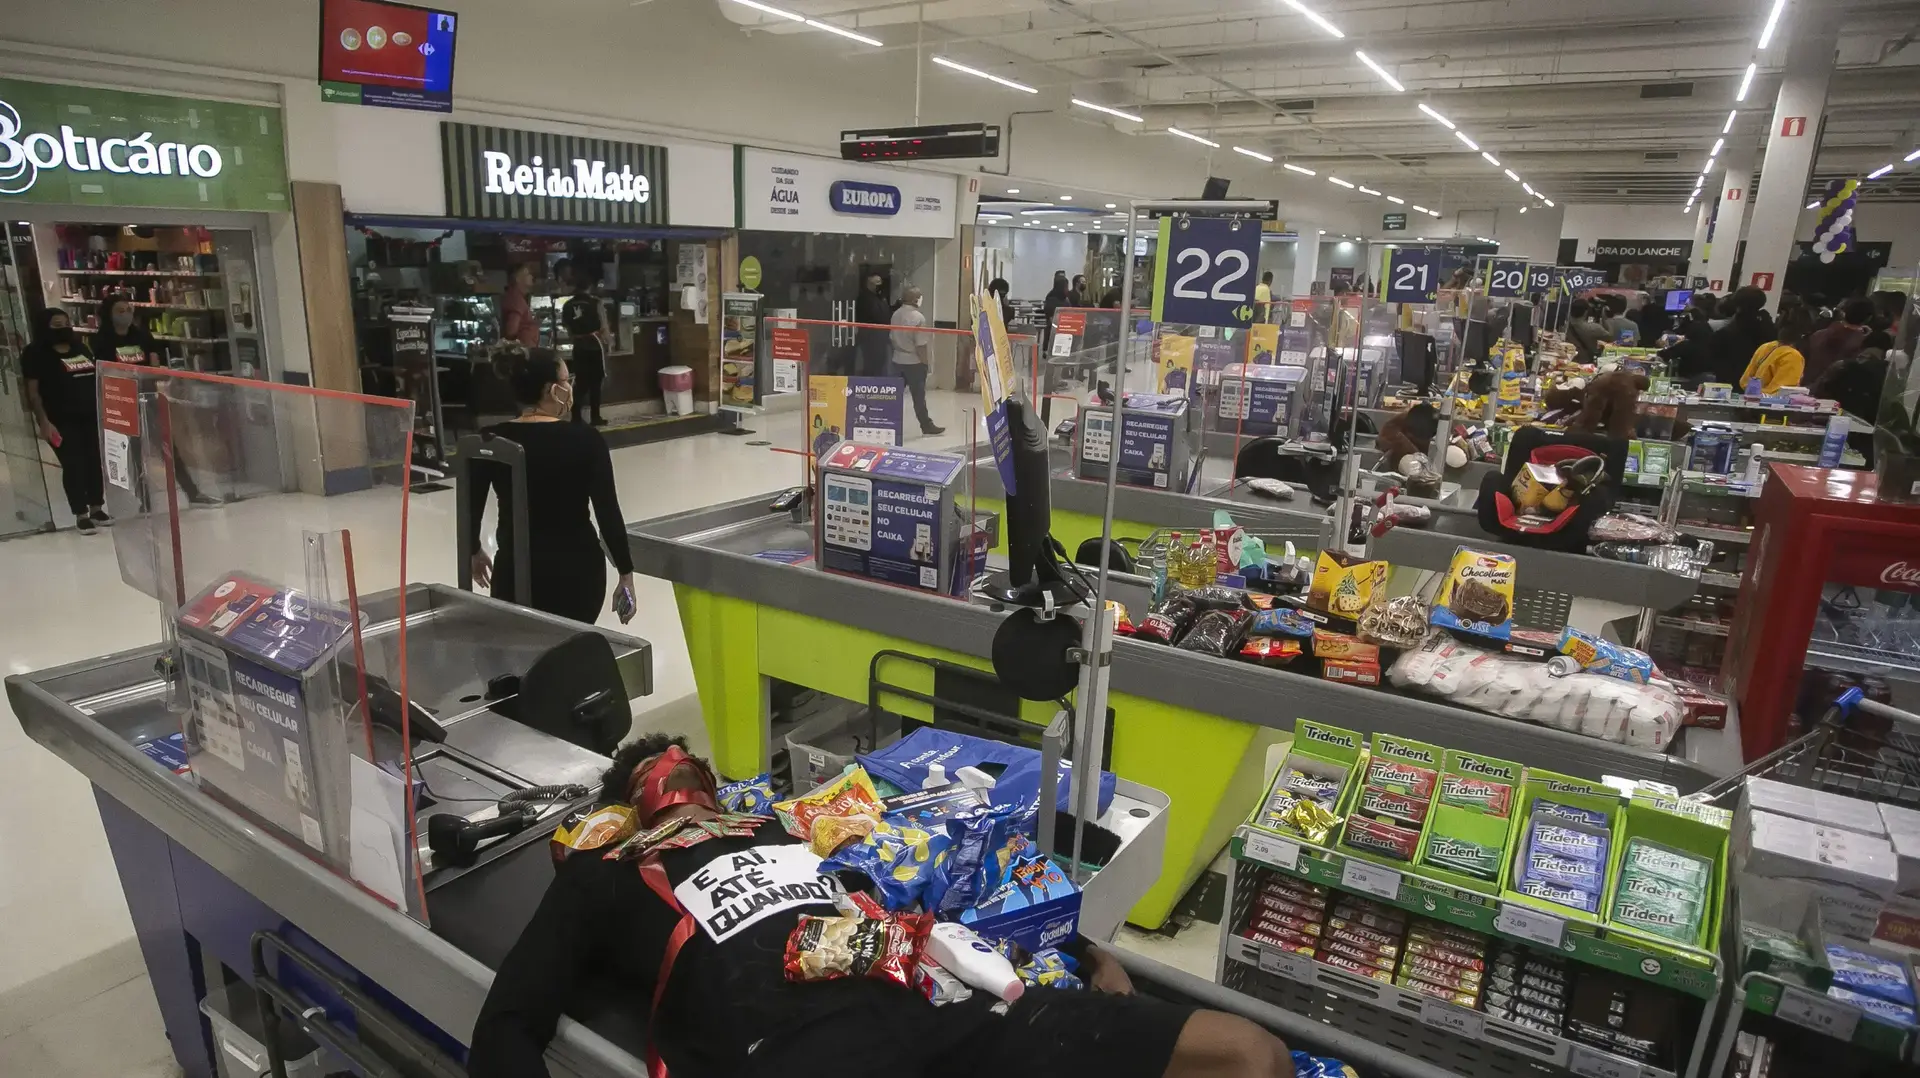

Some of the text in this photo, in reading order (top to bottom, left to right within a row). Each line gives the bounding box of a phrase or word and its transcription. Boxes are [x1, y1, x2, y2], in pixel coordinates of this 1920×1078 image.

[484, 151, 650, 204] Rei do Mate
[771, 186, 800, 203] ÁGUA
[842, 188, 895, 209] EUROPA
[1588, 246, 1681, 257] HORA DO LANCHE
[1173, 247, 1250, 302] 22
[1394, 263, 1429, 291] 21
[1491, 270, 1524, 289] 20
[1531, 272, 1549, 287] 19
[1567, 274, 1584, 289] 18
[855, 385, 897, 394] NOVO APP
[1126, 420, 1169, 431] RECARREGUE
[1138, 432, 1167, 441] CELULAR
[878, 489, 935, 505] RECARREGUE
[877, 503, 933, 519] SEU CELULAR
[877, 517, 890, 526] NO
[877, 530, 905, 542] CAIXA.
[1455, 618, 1490, 633] MOUSSE
[235, 670, 297, 709] RECARREGUE
[243, 718, 257, 733] NO
[255, 702, 299, 733] CELULAR
[1304, 725, 1355, 749] Trident
[1380, 740, 1434, 764] Trident
[1372, 765, 1420, 782] Trident
[1457, 756, 1514, 779] Trident
[1290, 776, 1333, 789] Trident
[1443, 781, 1492, 796] Trident
[1548, 780, 1592, 795] Trident
[1364, 795, 1412, 812] Trident
[1350, 832, 1399, 849] Trident
[1537, 828, 1590, 846] Trident
[1433, 841, 1485, 859] Trident
[1532, 857, 1588, 873] Trident
[1633, 849, 1687, 870] Trident
[692, 868, 718, 891] E
[1418, 880, 1449, 894] Trident
[710, 867, 775, 909] ATÉ
[1267, 883, 1298, 897] HALLS
[1524, 884, 1580, 900] Trident
[1627, 878, 1684, 899] Trident
[706, 874, 838, 937] QUANDO?
[1448, 905, 1476, 917] Trident
[1618, 903, 1677, 924] Trident
[1262, 909, 1293, 924] HALLS
[1039, 918, 1074, 947] SUCRILHOS
[1258, 920, 1289, 935] HALLS
[1252, 932, 1284, 947] HALLS
[1334, 929, 1365, 944] HALLS
[1330, 941, 1361, 957] HALLS
[1327, 954, 1359, 970] HALLS
[1410, 965, 1444, 981] HALLS
[1524, 961, 1563, 980] HALLS
[1406, 978, 1440, 993] HALLS
[1522, 974, 1564, 994] HALLS
[1520, 987, 1561, 1008] HALLS
[1516, 1002, 1556, 1022] HALLS
